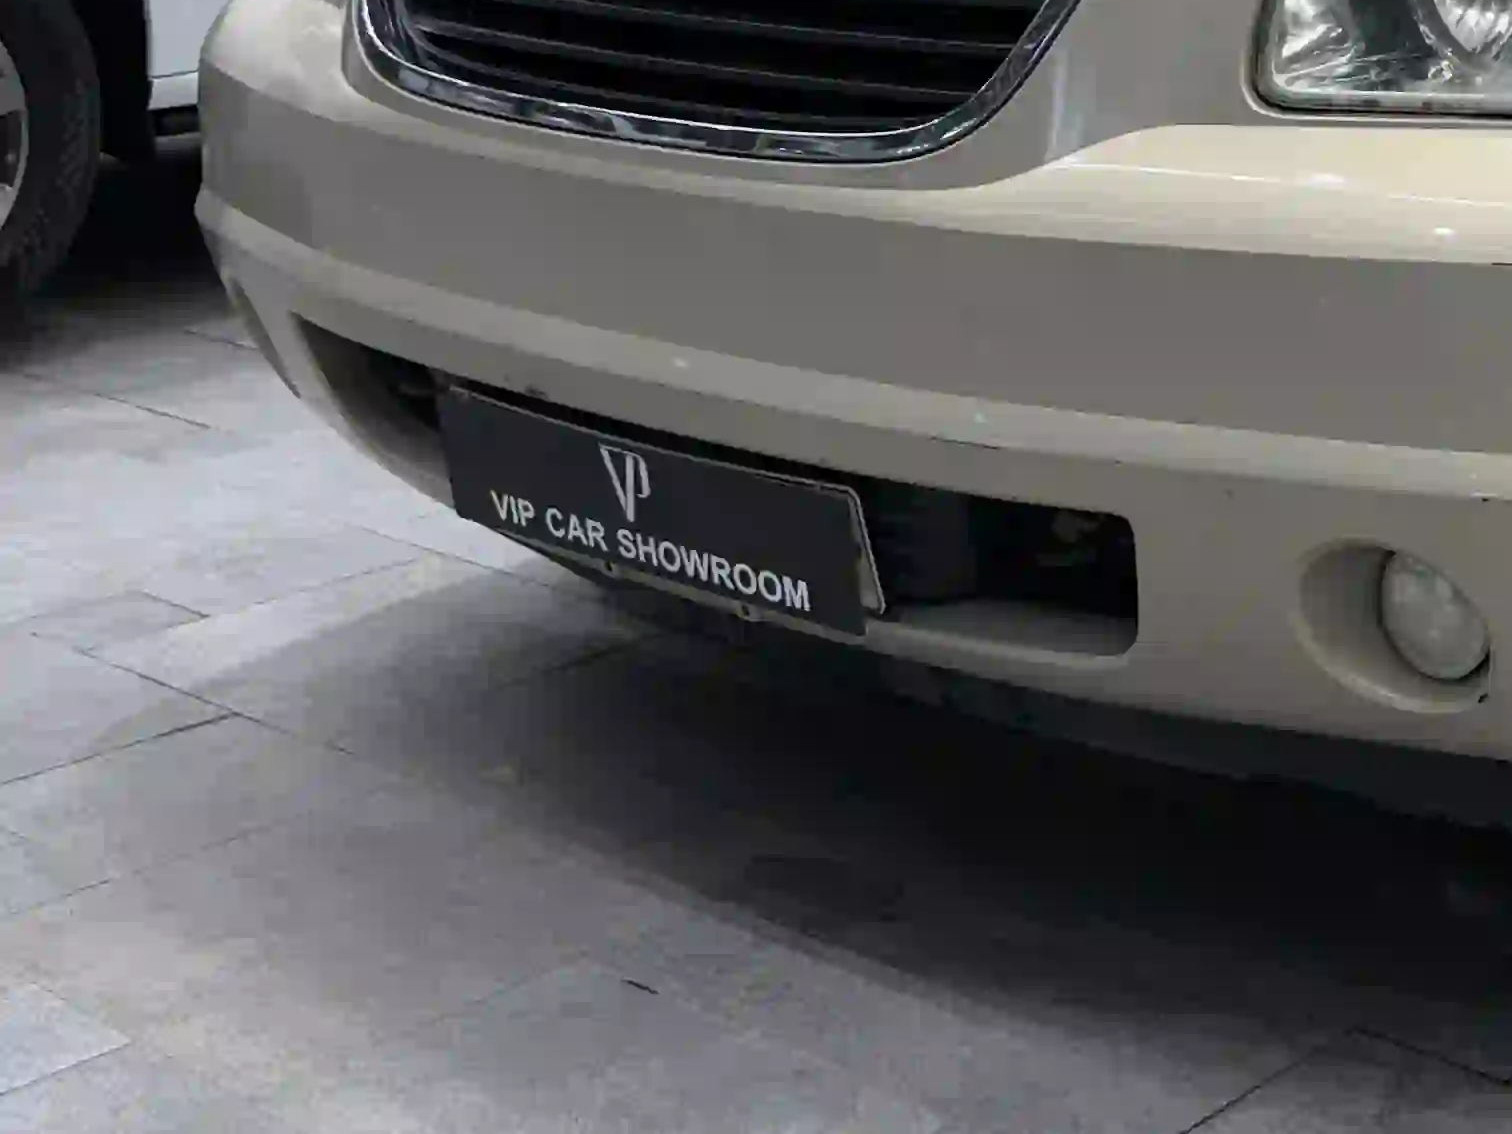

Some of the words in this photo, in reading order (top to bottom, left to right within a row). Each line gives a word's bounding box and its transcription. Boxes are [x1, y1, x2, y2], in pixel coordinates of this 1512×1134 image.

[489, 488, 536, 528] VIP
[545, 507, 609, 553] CAR
[616, 528, 812, 613] SHOWROOM
